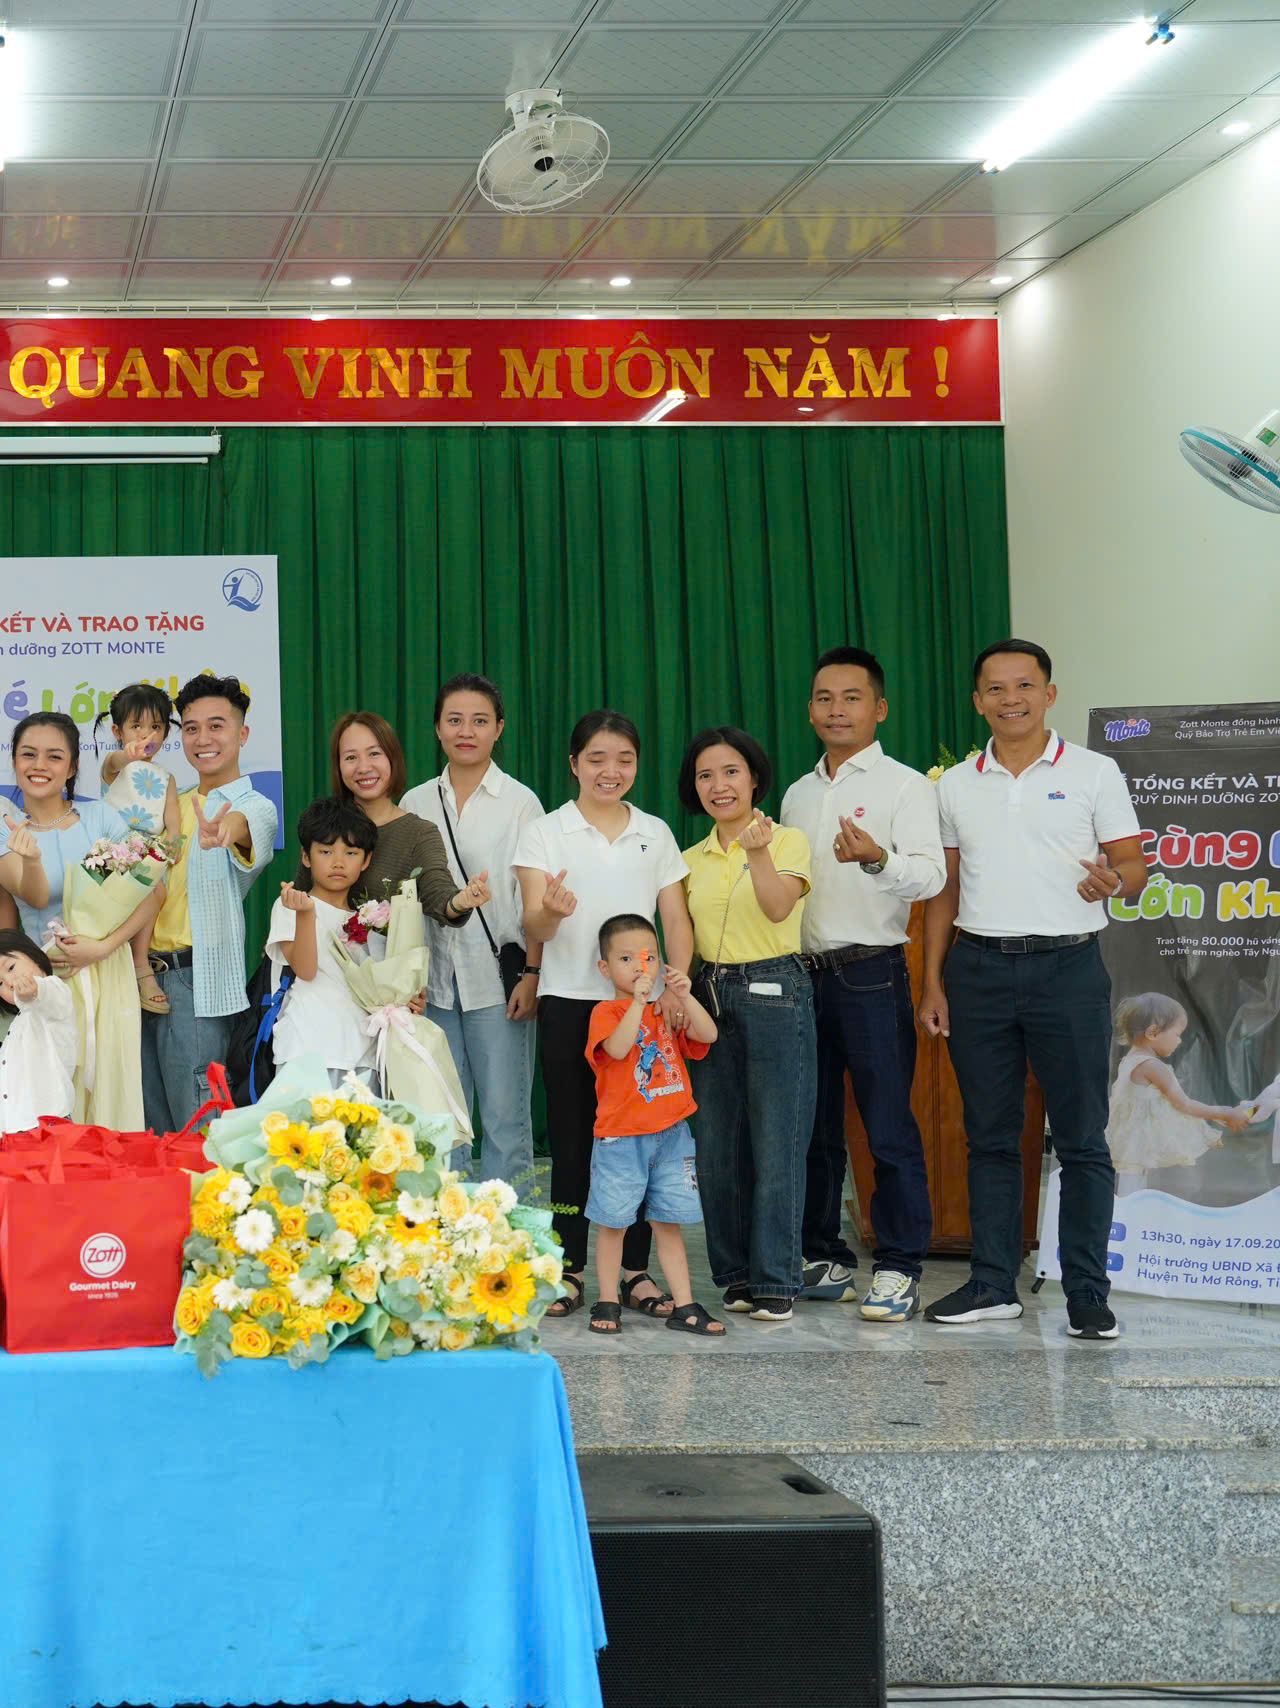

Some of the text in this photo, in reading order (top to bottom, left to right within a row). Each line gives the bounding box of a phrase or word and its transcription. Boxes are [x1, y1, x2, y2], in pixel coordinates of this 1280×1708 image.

[9, 346, 265, 409] QUANG
[283, 347, 472, 399] VINH
[499, 331, 715, 400] MUÔN
[744, 332, 912, 399] NĂM
[41, 612, 72, 633] VÀ
[78, 616, 139, 632] TRAO
[145, 611, 205, 636] TẶNG
[9, 642, 57, 658] dưỡng
[61, 642, 103, 655] ZOTT
[107, 641, 166, 655] MONTE
[1104, 719, 1151, 742] Monte
[1180, 720, 1199, 728] Zott
[1201, 719, 1230, 728] Monte
[1250, 727, 1265, 736] Em
[1132, 774, 1185, 790] TỔNG
[1190, 772, 1227, 790] KẾT
[1232, 773, 1259, 789] VÀ
[1129, 792, 1159, 805] QUỸ
[1163, 795, 1198, 804] DINH
[1202, 792, 1255, 804] DƯỠNG
[1156, 937, 1175, 945] Trao
[1177, 936, 1199, 946] tặng
[1201, 936, 1244, 946] 80.000
[1160, 947, 1175, 956] cho
[1192, 948, 1207, 956] em
[1209, 948, 1240, 958] nghèo
[1242, 948, 1260, 958] Tây
[1141, 1230, 1186, 1246] 13h30,
[1190, 1236, 1222, 1248] ngày
[87, 1246, 123, 1264] Zott
[1138, 1253, 1161, 1266] Hội
[1165, 1257, 1208, 1271] trường
[1212, 1261, 1252, 1272] UBND
[1255, 1262, 1272, 1273] Xã
[69, 1280, 136, 1291] Gourmet Dairy
[1137, 1268, 1179, 1282] Huyện
[1183, 1273, 1198, 1284] Tu
[1202, 1275, 1222, 1285] Mơ
[1225, 1276, 1263, 1288] Rông,
